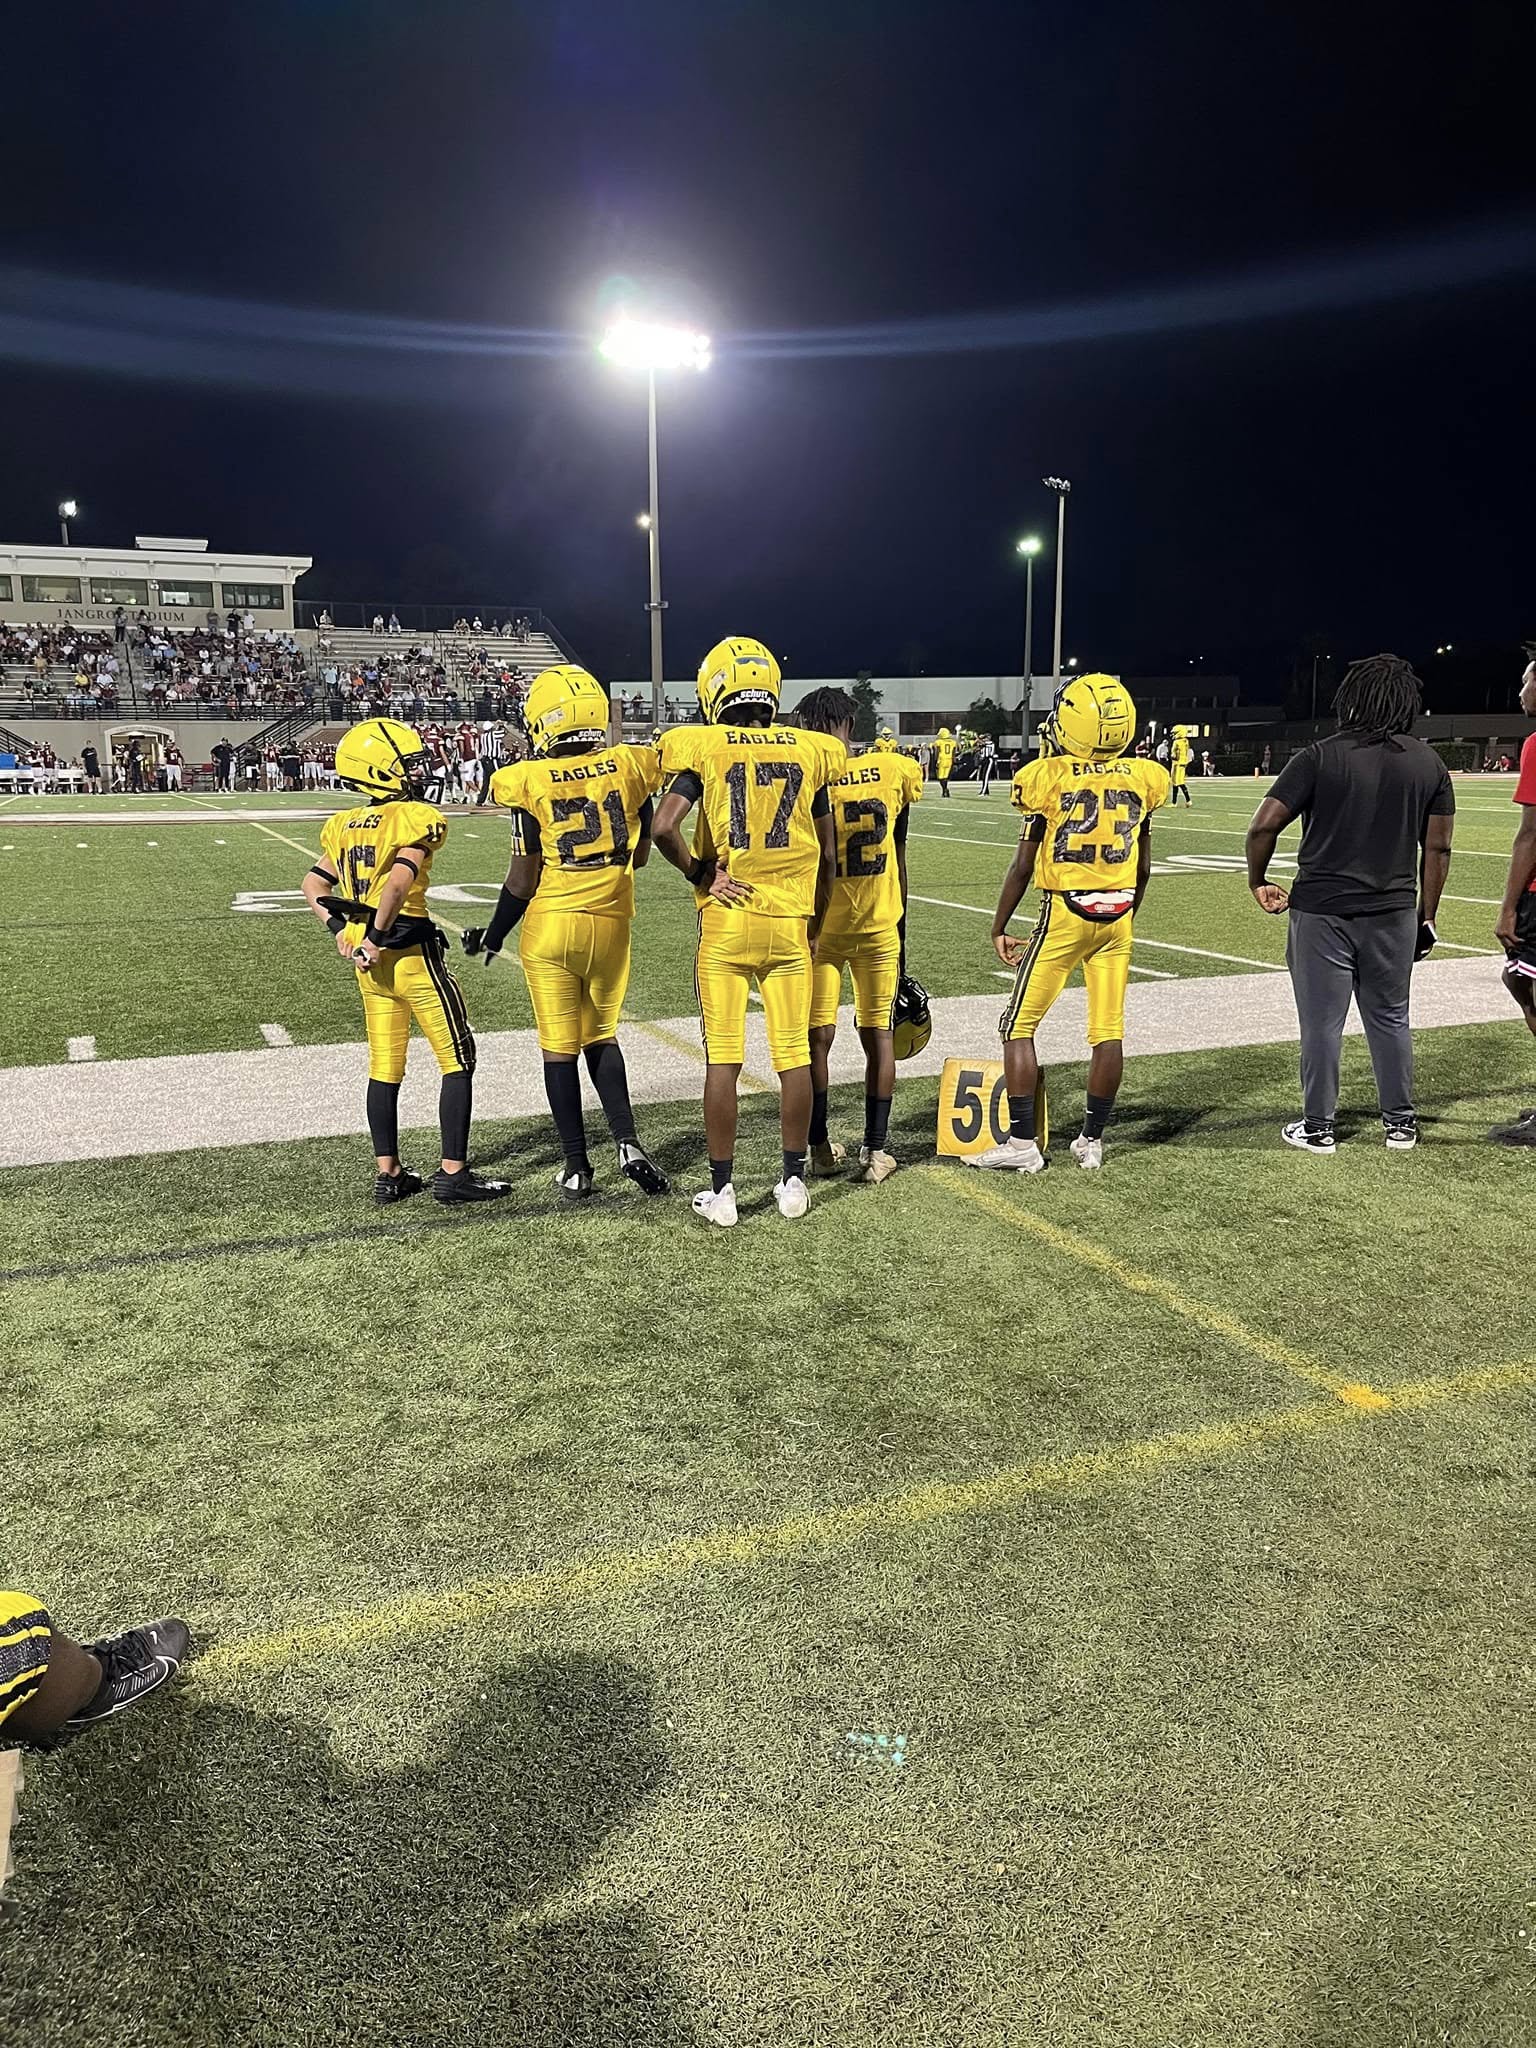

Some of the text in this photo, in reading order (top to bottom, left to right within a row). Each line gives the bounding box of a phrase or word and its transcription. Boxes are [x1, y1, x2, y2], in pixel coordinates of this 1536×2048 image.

[122, 610, 184, 622] TDIUM
[725, 731, 797, 745] EAGLES
[549, 759, 618, 783] EAGLES
[827, 767, 880, 787] GLES
[725, 762, 804, 850] 17
[551, 789, 632, 867] 21
[1053, 788, 1143, 865] 23
